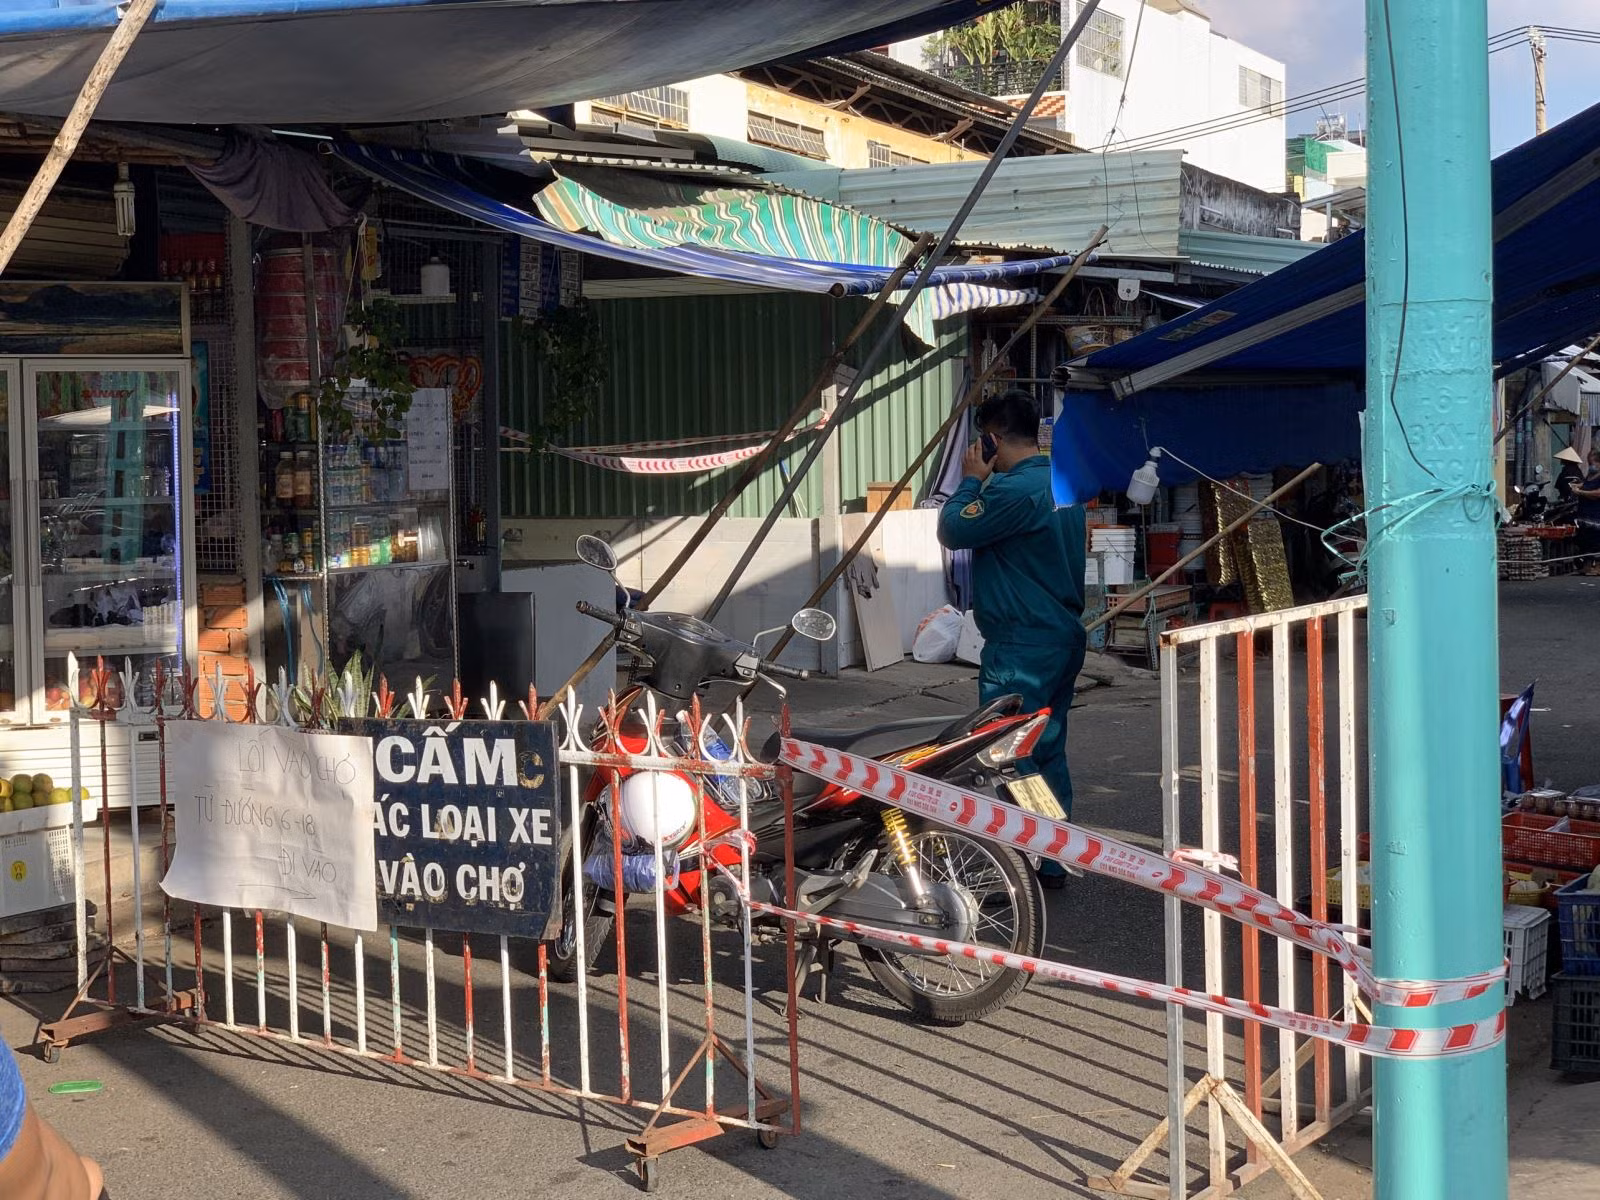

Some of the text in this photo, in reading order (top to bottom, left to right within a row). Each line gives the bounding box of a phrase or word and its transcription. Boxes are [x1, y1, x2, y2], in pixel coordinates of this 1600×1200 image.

[376, 722, 518, 786] CẤM
[421, 803, 497, 848] LOẠI
[508, 807, 552, 846] XE
[378, 852, 527, 912] VÀO CHỢ
